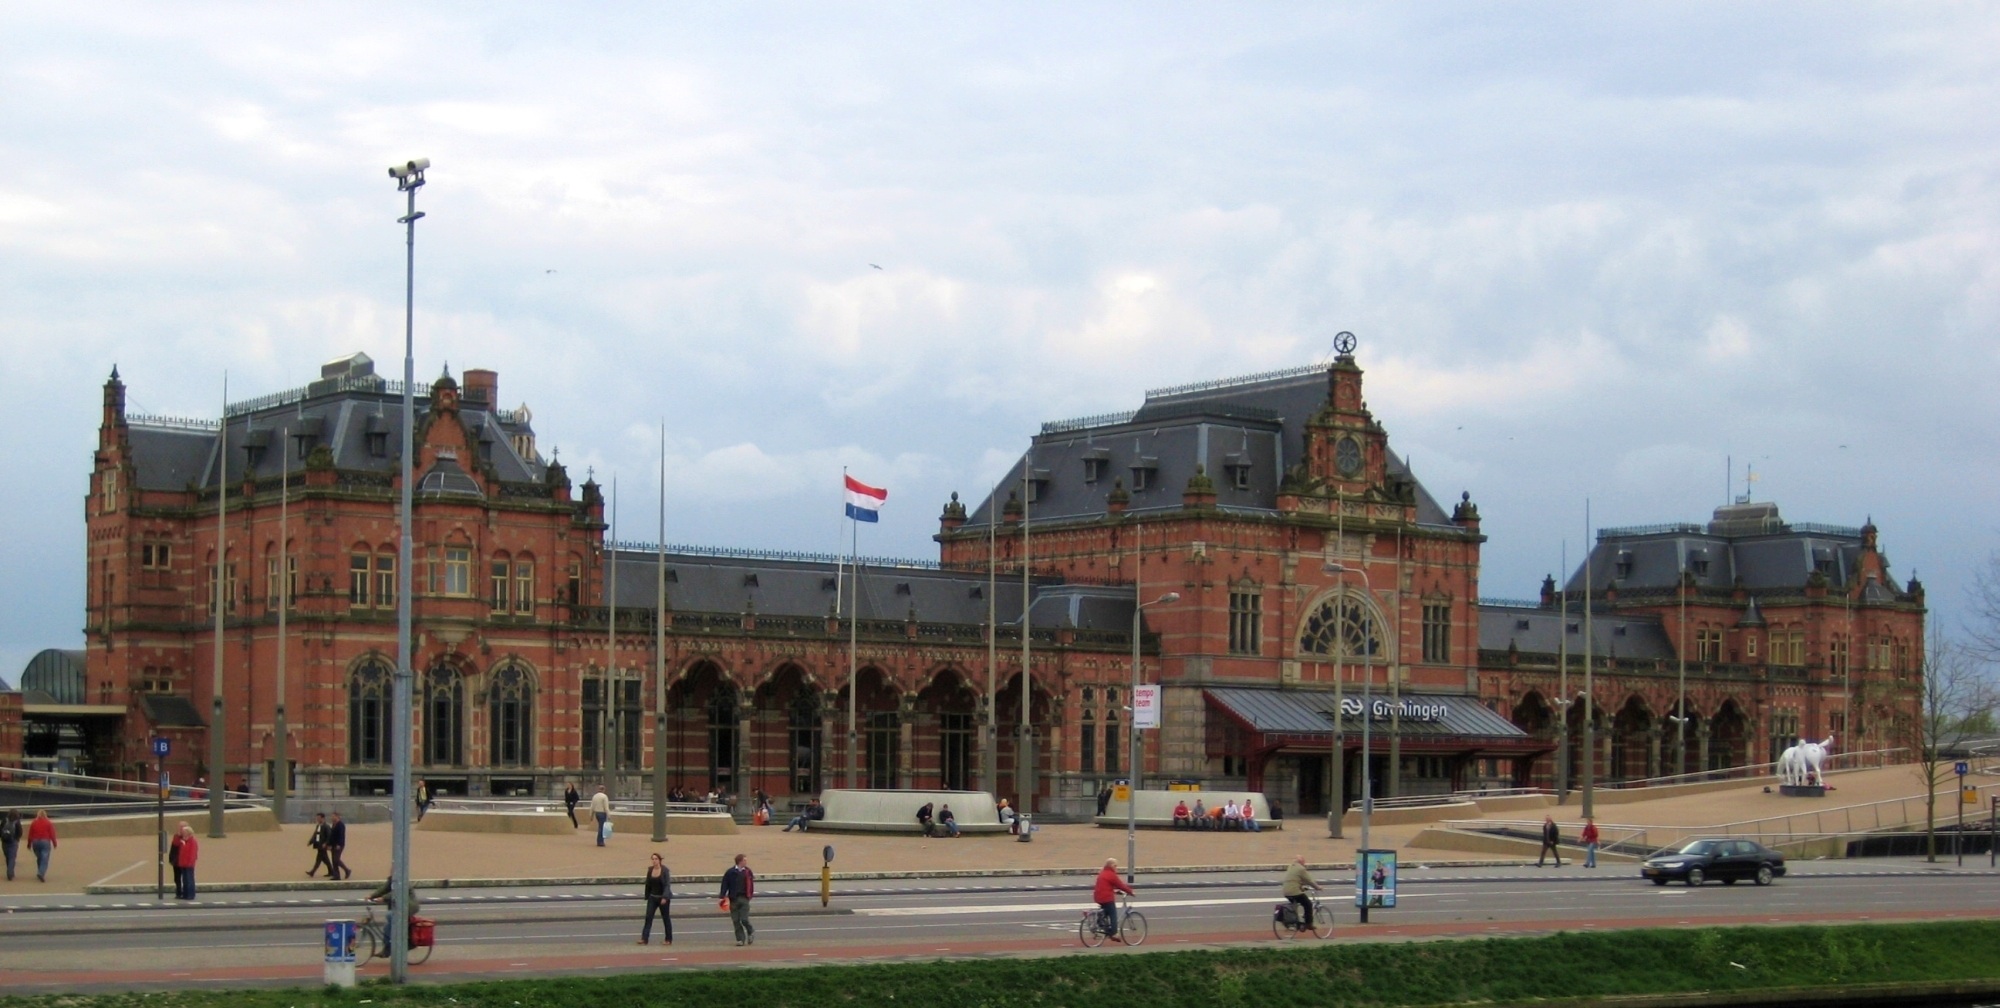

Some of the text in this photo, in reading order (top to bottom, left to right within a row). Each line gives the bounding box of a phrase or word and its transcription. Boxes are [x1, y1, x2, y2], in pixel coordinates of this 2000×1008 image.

[1135, 689, 1154, 699] tempo
[1135, 699, 1151, 707] team
[160, 742, 168, 752] B
